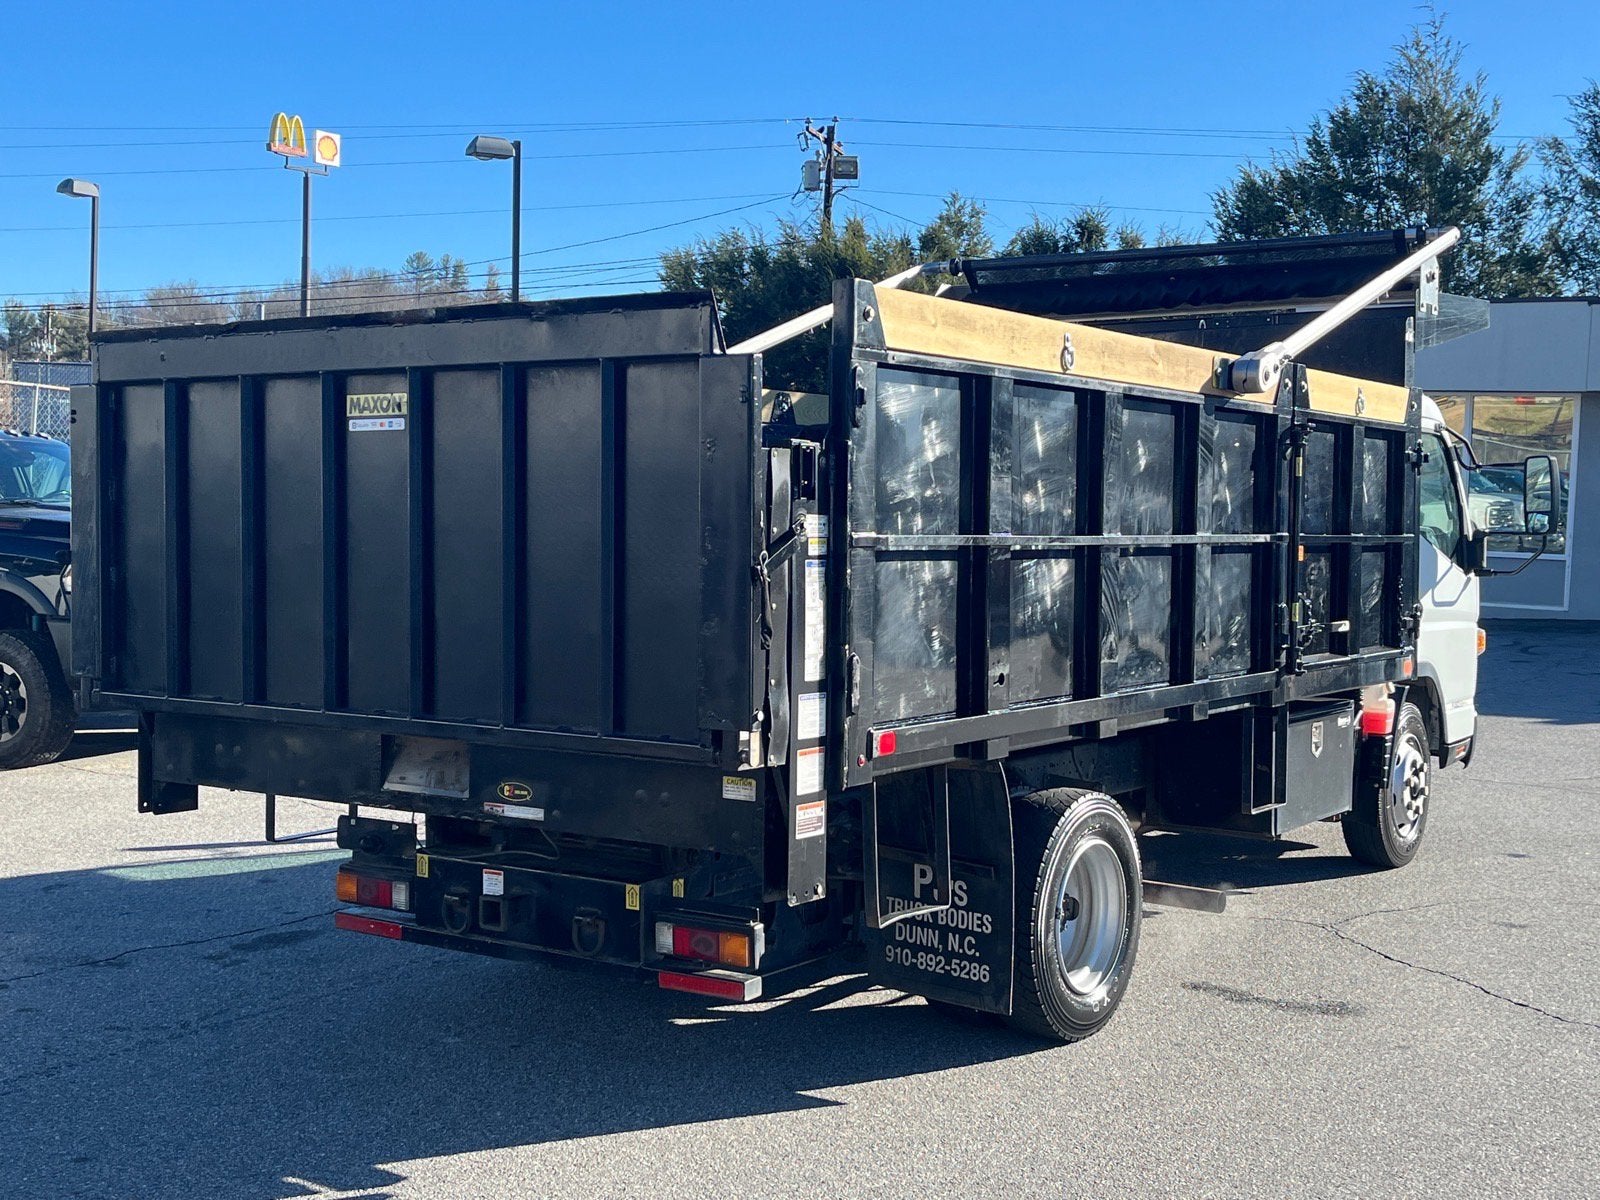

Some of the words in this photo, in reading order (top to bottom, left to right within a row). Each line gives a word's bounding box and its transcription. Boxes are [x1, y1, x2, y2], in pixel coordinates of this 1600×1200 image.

[349, 396, 402, 414] MAXON
[726, 778, 753, 787] CAUTION
[937, 907, 992, 934] BODIES
[895, 921, 943, 953] DUNN,
[947, 932, 980, 957] N.C.
[885, 944, 990, 983] 910-892-5286
